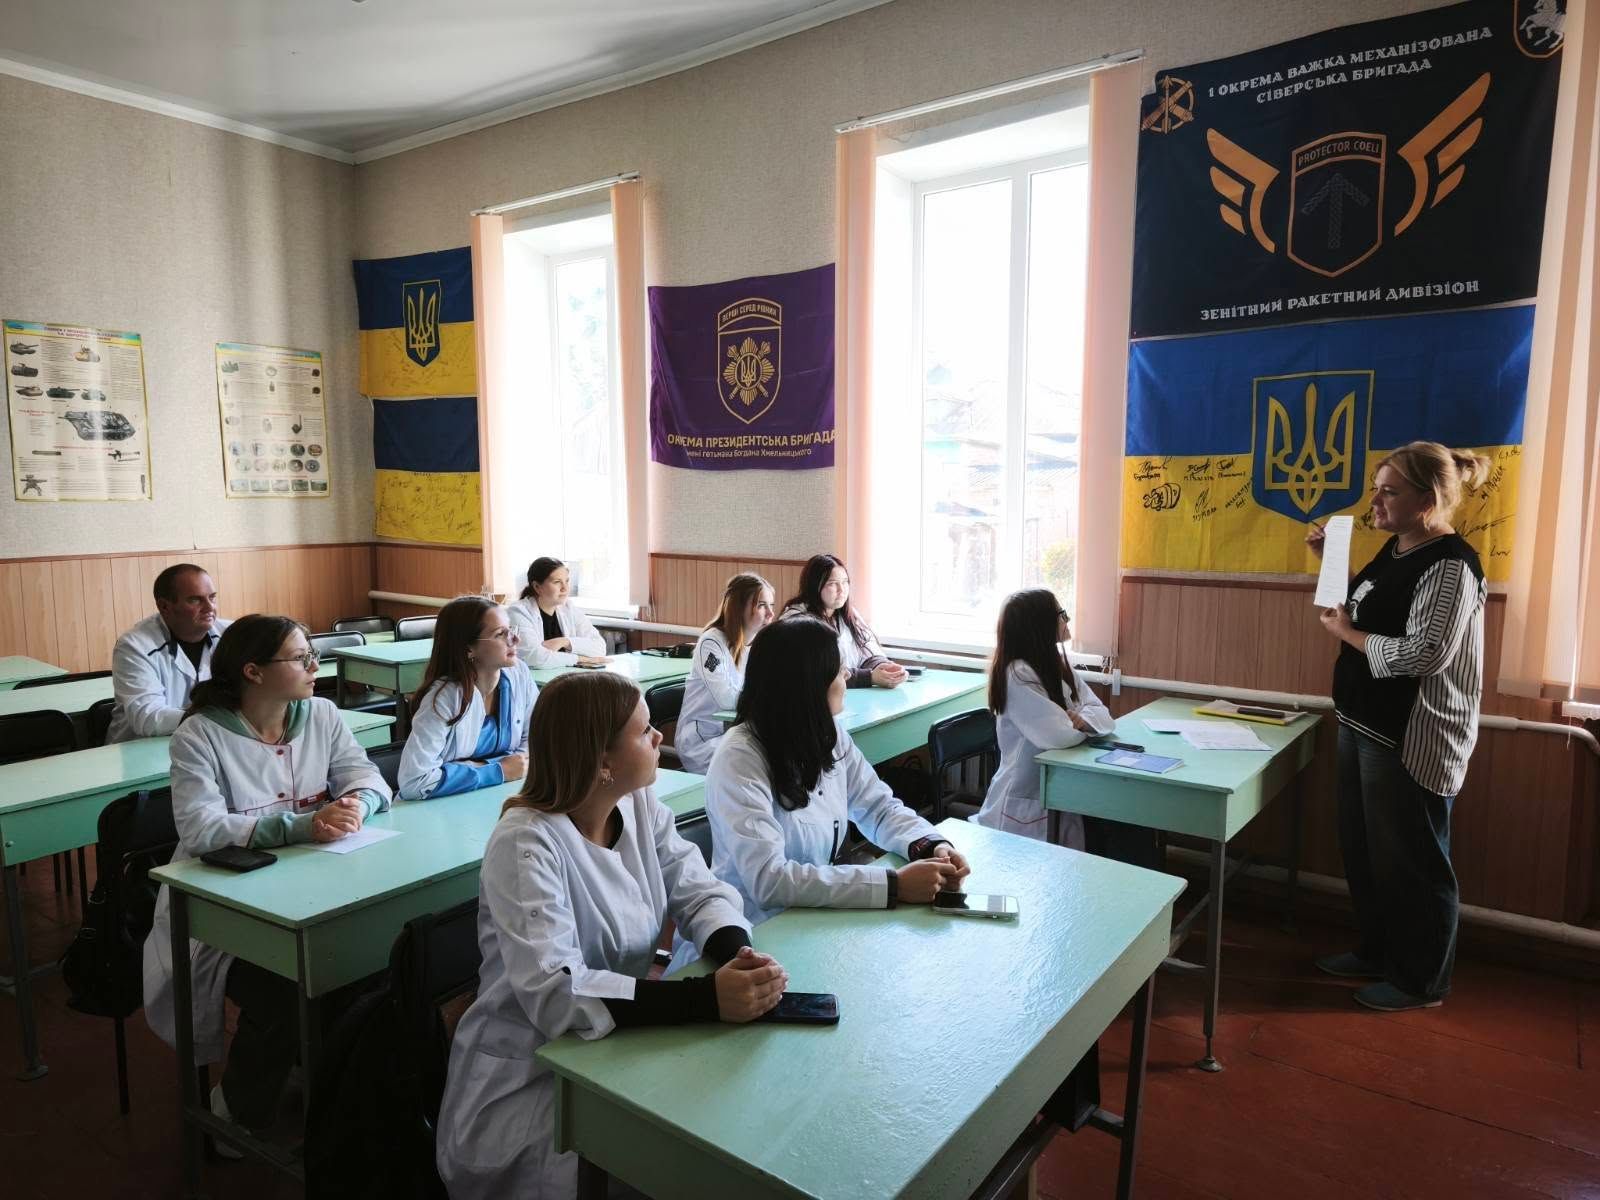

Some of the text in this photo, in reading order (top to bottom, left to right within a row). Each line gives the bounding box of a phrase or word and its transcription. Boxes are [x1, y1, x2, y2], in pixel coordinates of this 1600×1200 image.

[1218, 71, 1284, 96] ОКРЕМА
[1287, 55, 1347, 79] ВАЖКА
[1349, 26, 1493, 64] МЕХАНІЗОВАНА
[1256, 58, 1433, 104] СІВЕРСЬКА БРИГАДА
[1298, 140, 1380, 167] PROTECTOR COELI
[1200, 280, 1480, 321] ЗЕНІТНИЙ РАКЕТНИЙ ДИВІЗІОН
[705, 434, 788, 449] ПРЕЗИДЕНТСЬКА
[790, 430, 839, 446] БРИГАДА
